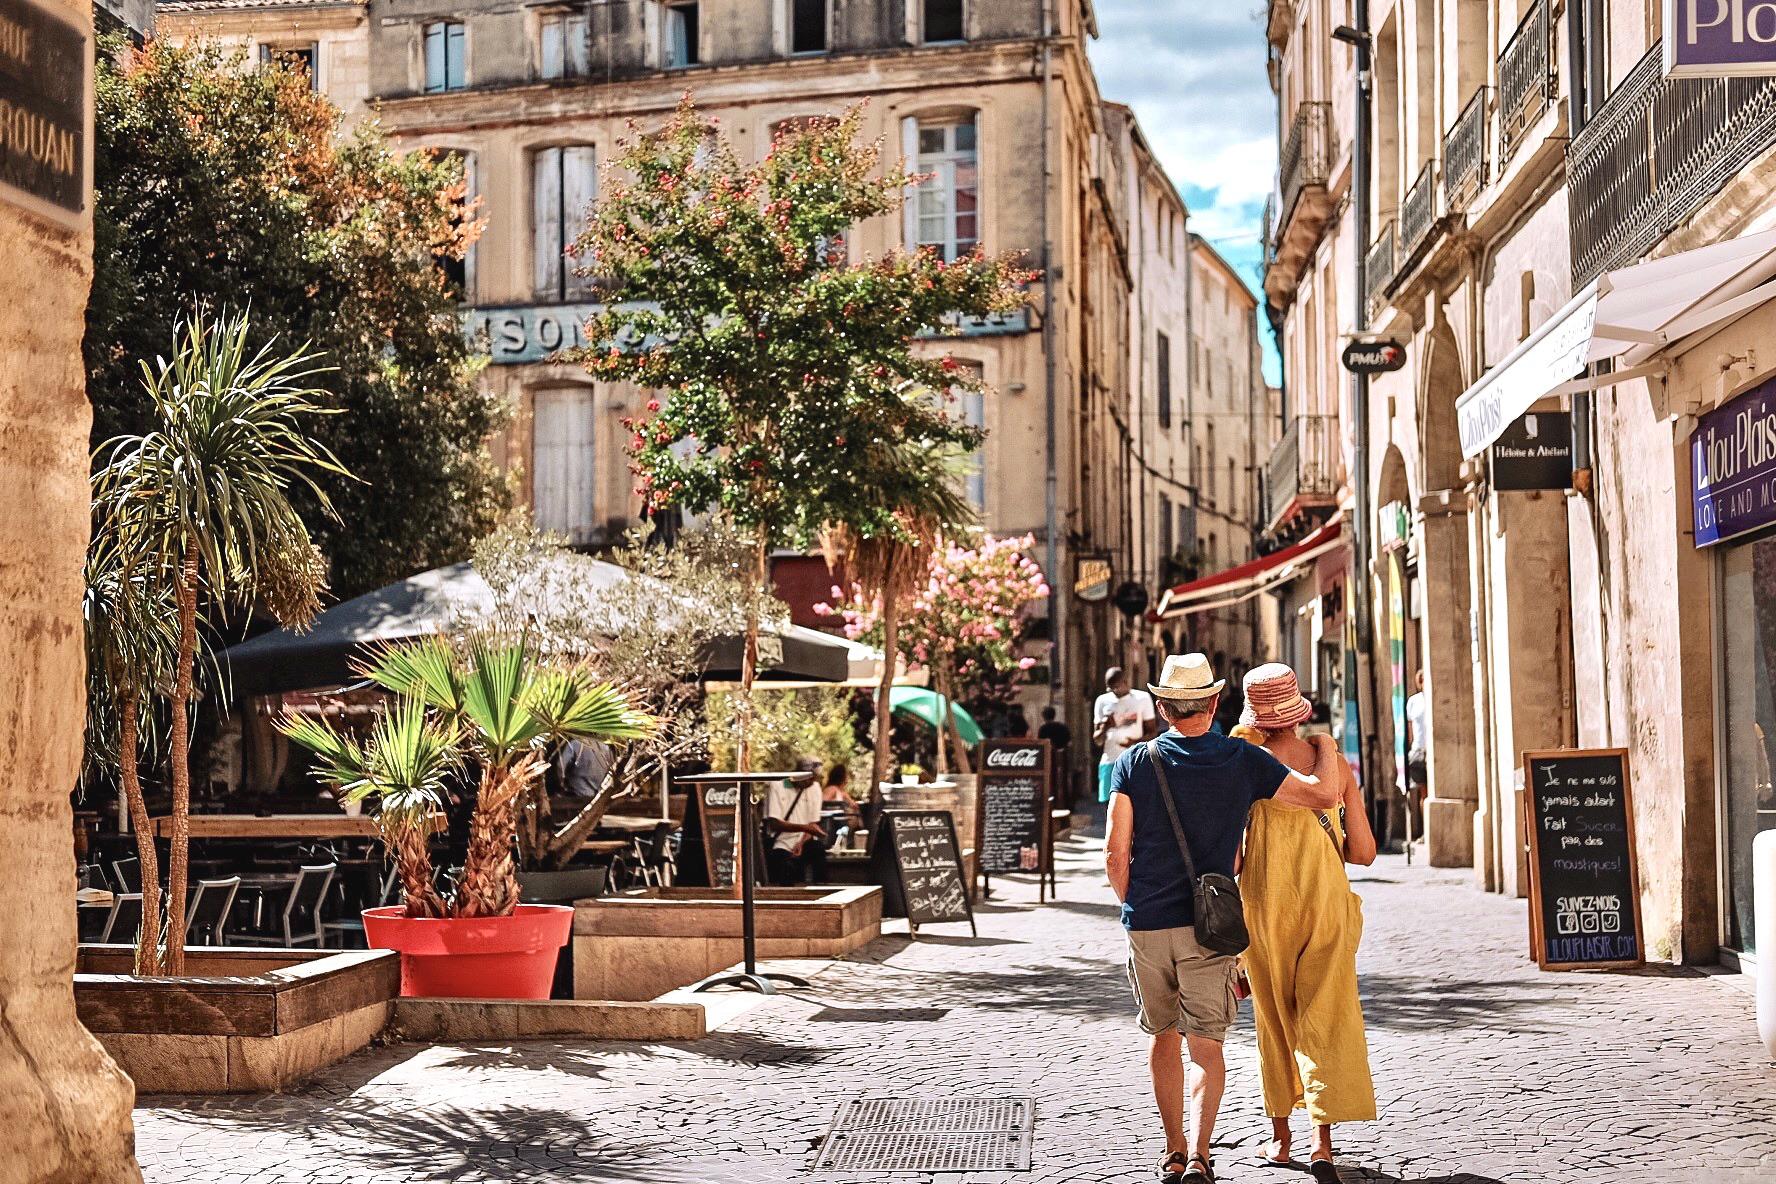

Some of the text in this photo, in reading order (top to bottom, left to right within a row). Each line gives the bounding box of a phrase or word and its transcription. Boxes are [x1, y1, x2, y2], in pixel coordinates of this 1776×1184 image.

[1527, 448, 1535, 457] &
[1731, 488, 1753, 518] AND
[1567, 778, 1579, 786] ne
[1582, 777, 1596, 785] me
[1599, 774, 1617, 786] suis
[1542, 794, 1580, 812] jamais
[1544, 816, 1567, 830] Fait
[1584, 835, 1604, 846] des
[1556, 895, 1620, 912] SUIVEZ-NOUS
